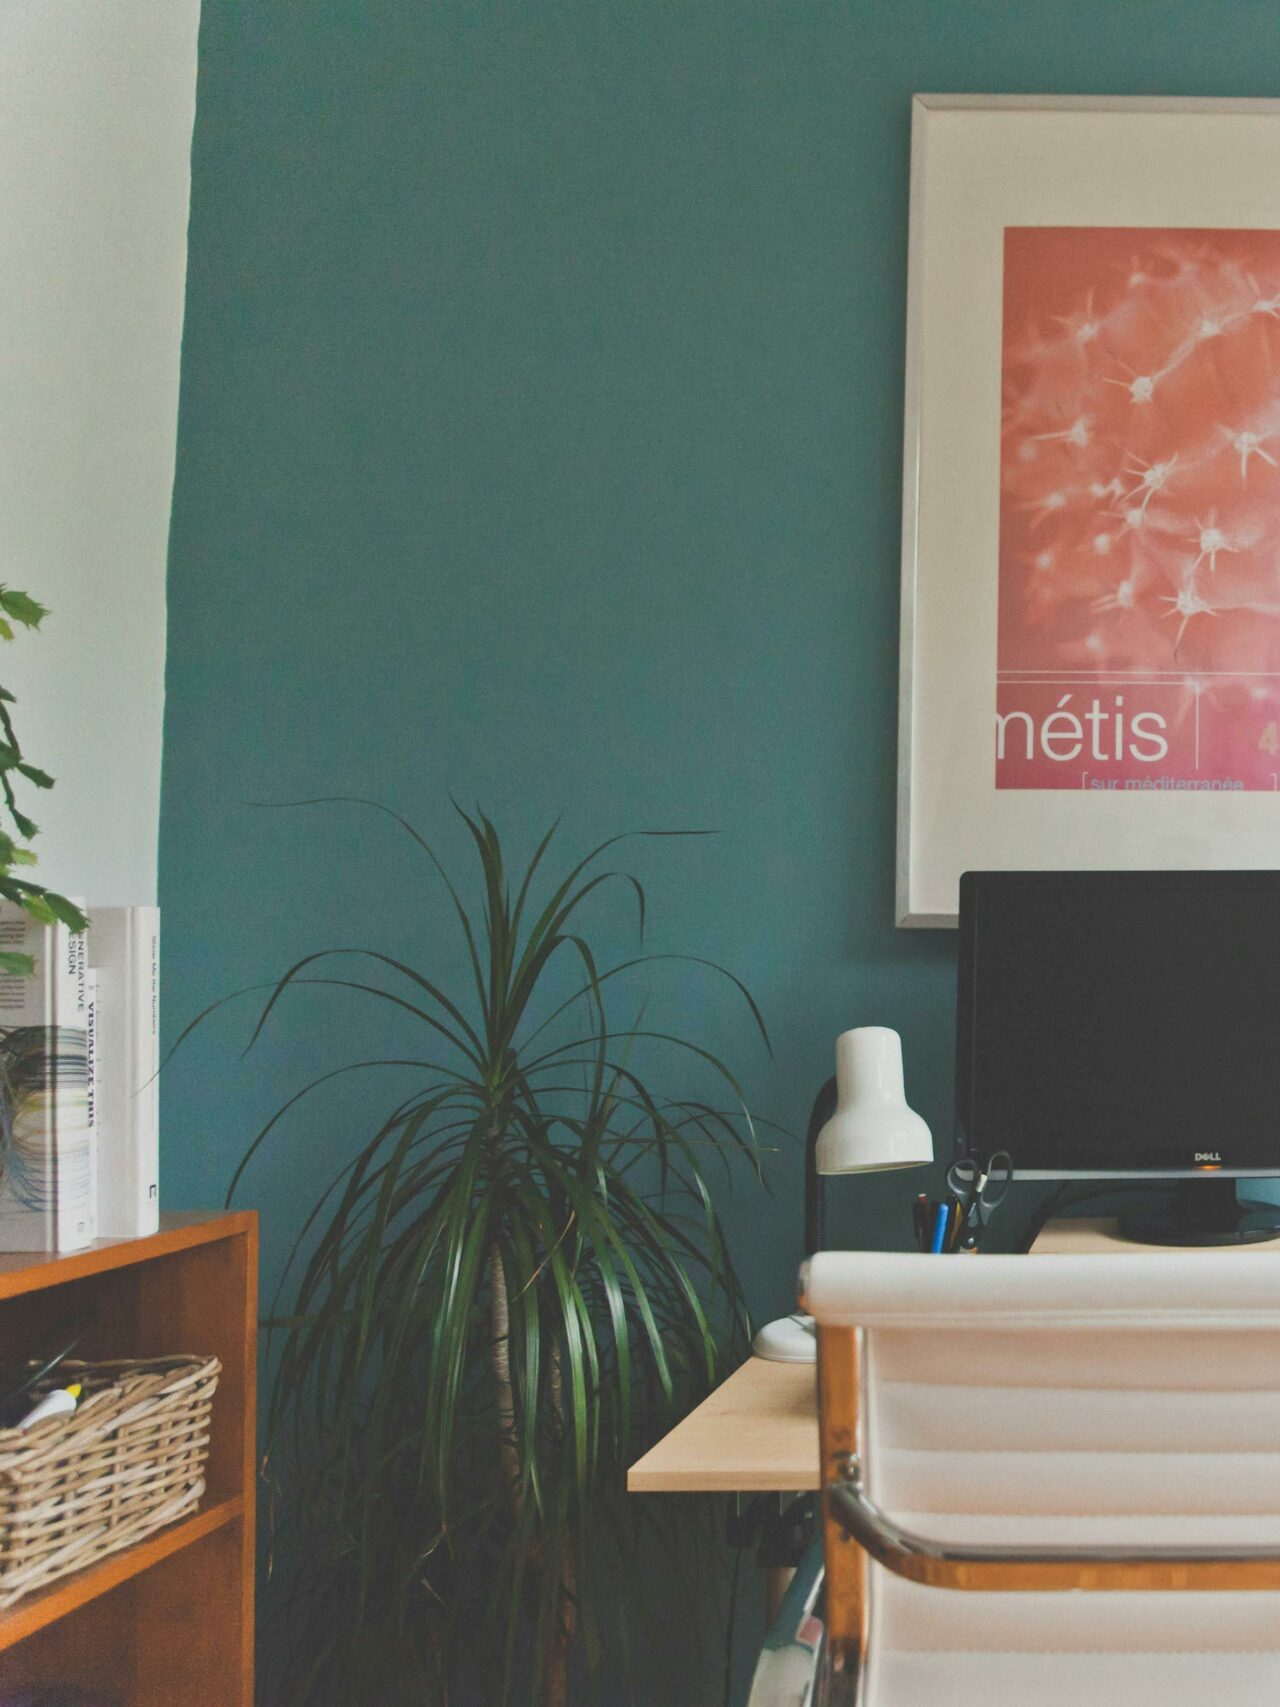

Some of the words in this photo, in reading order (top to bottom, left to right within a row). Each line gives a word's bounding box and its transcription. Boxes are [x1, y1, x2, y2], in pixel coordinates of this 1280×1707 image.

[1258, 722, 1278, 755] 4
[1091, 778, 1118, 790] sur
[1126, 776, 1244, 791] méditerranée
[1195, 1152, 1222, 1161] DELL
